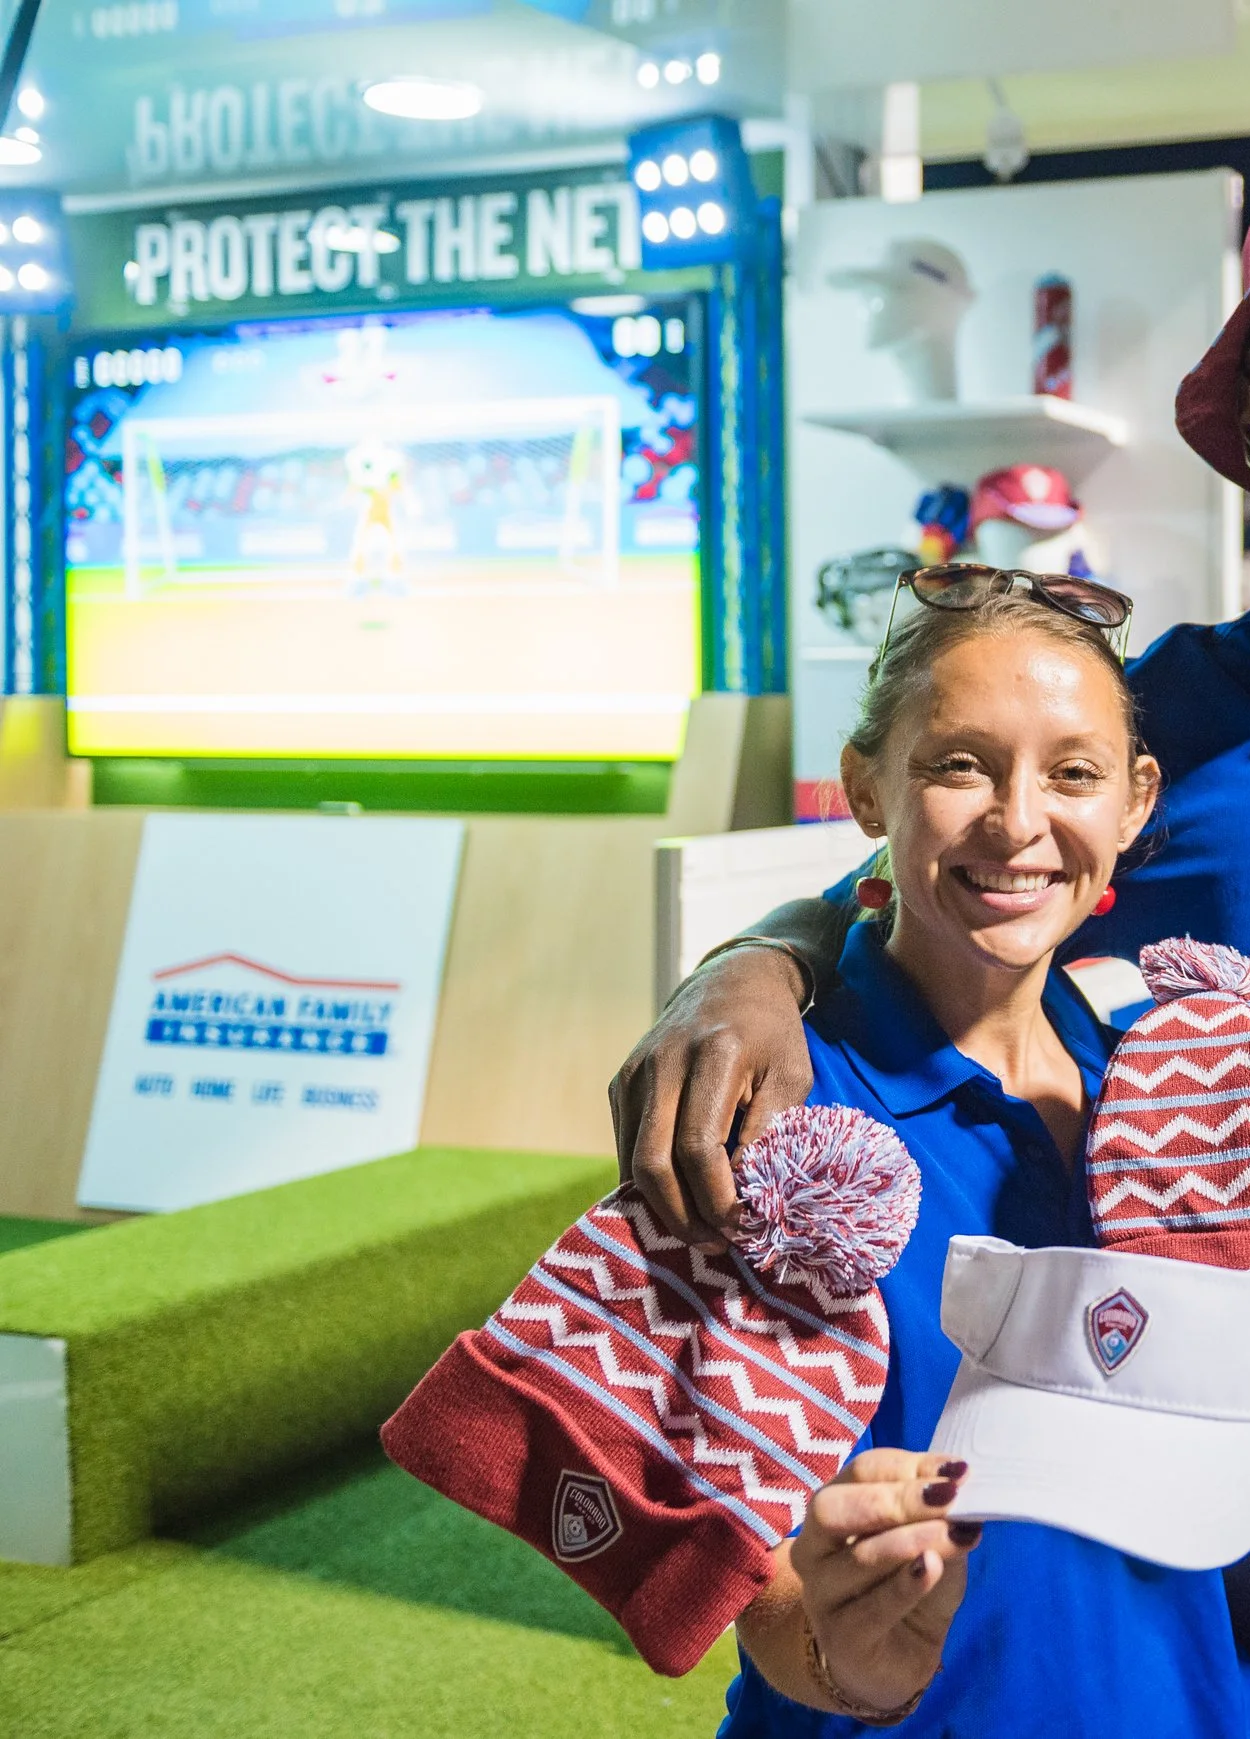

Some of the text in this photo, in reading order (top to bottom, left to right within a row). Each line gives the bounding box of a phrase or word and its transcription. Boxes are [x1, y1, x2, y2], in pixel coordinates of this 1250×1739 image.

[136, 182, 643, 305] PROTECT THE NET
[153, 990, 391, 1021] AMERICAN FAMILY
[569, 1488, 608, 1530] COLORADO
